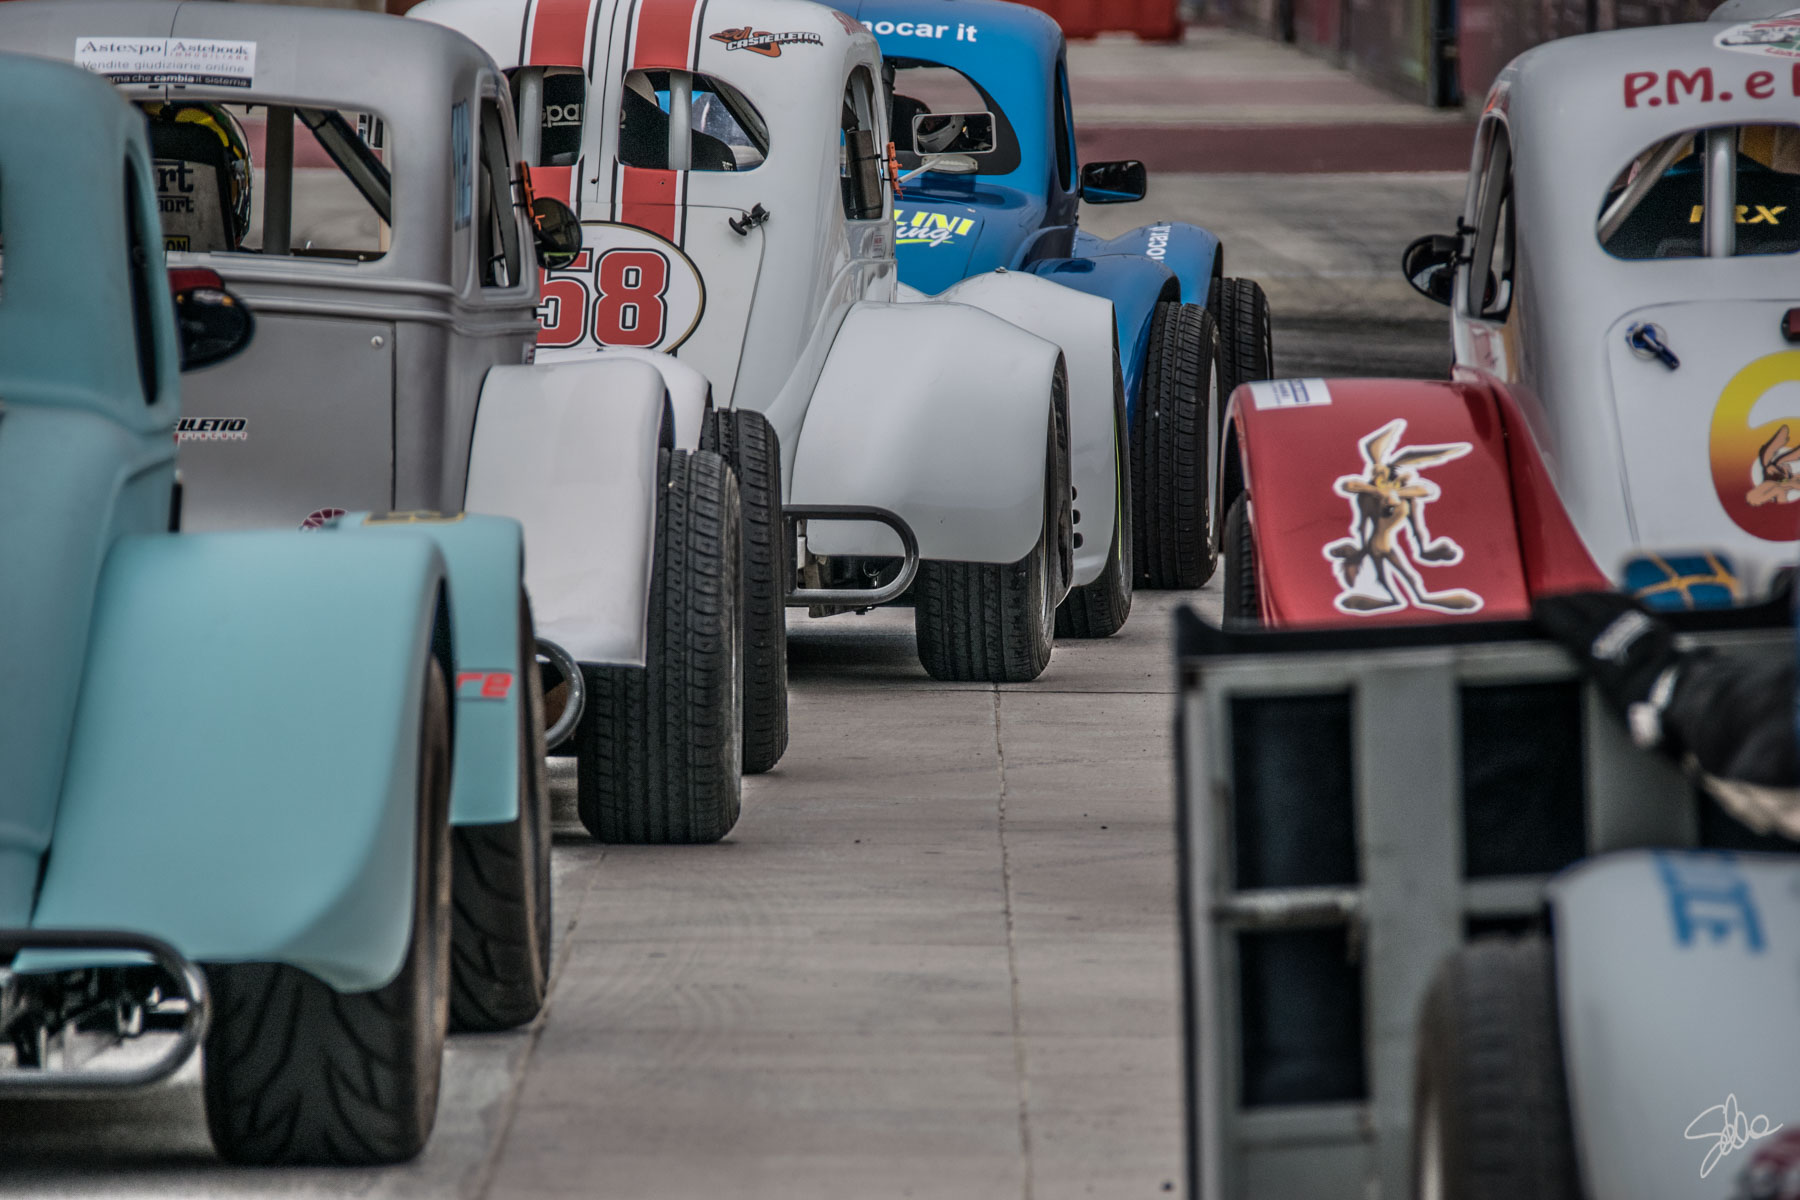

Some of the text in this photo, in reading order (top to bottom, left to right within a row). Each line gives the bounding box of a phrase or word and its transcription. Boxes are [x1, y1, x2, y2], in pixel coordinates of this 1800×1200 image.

[82, 41, 248, 55] Astexpo Astebook
[726, 32, 821, 51] CASTELLETTO
[81, 60, 244, 73] Vendite giudiziarie online
[132, 73, 151, 82] che
[154, 74, 194, 83] cambia
[1624, 67, 1733, 108] P.M.
[1745, 70, 1775, 100] e
[536, 247, 671, 349] 58
[182, 431, 247, 440] CIRCUIT
